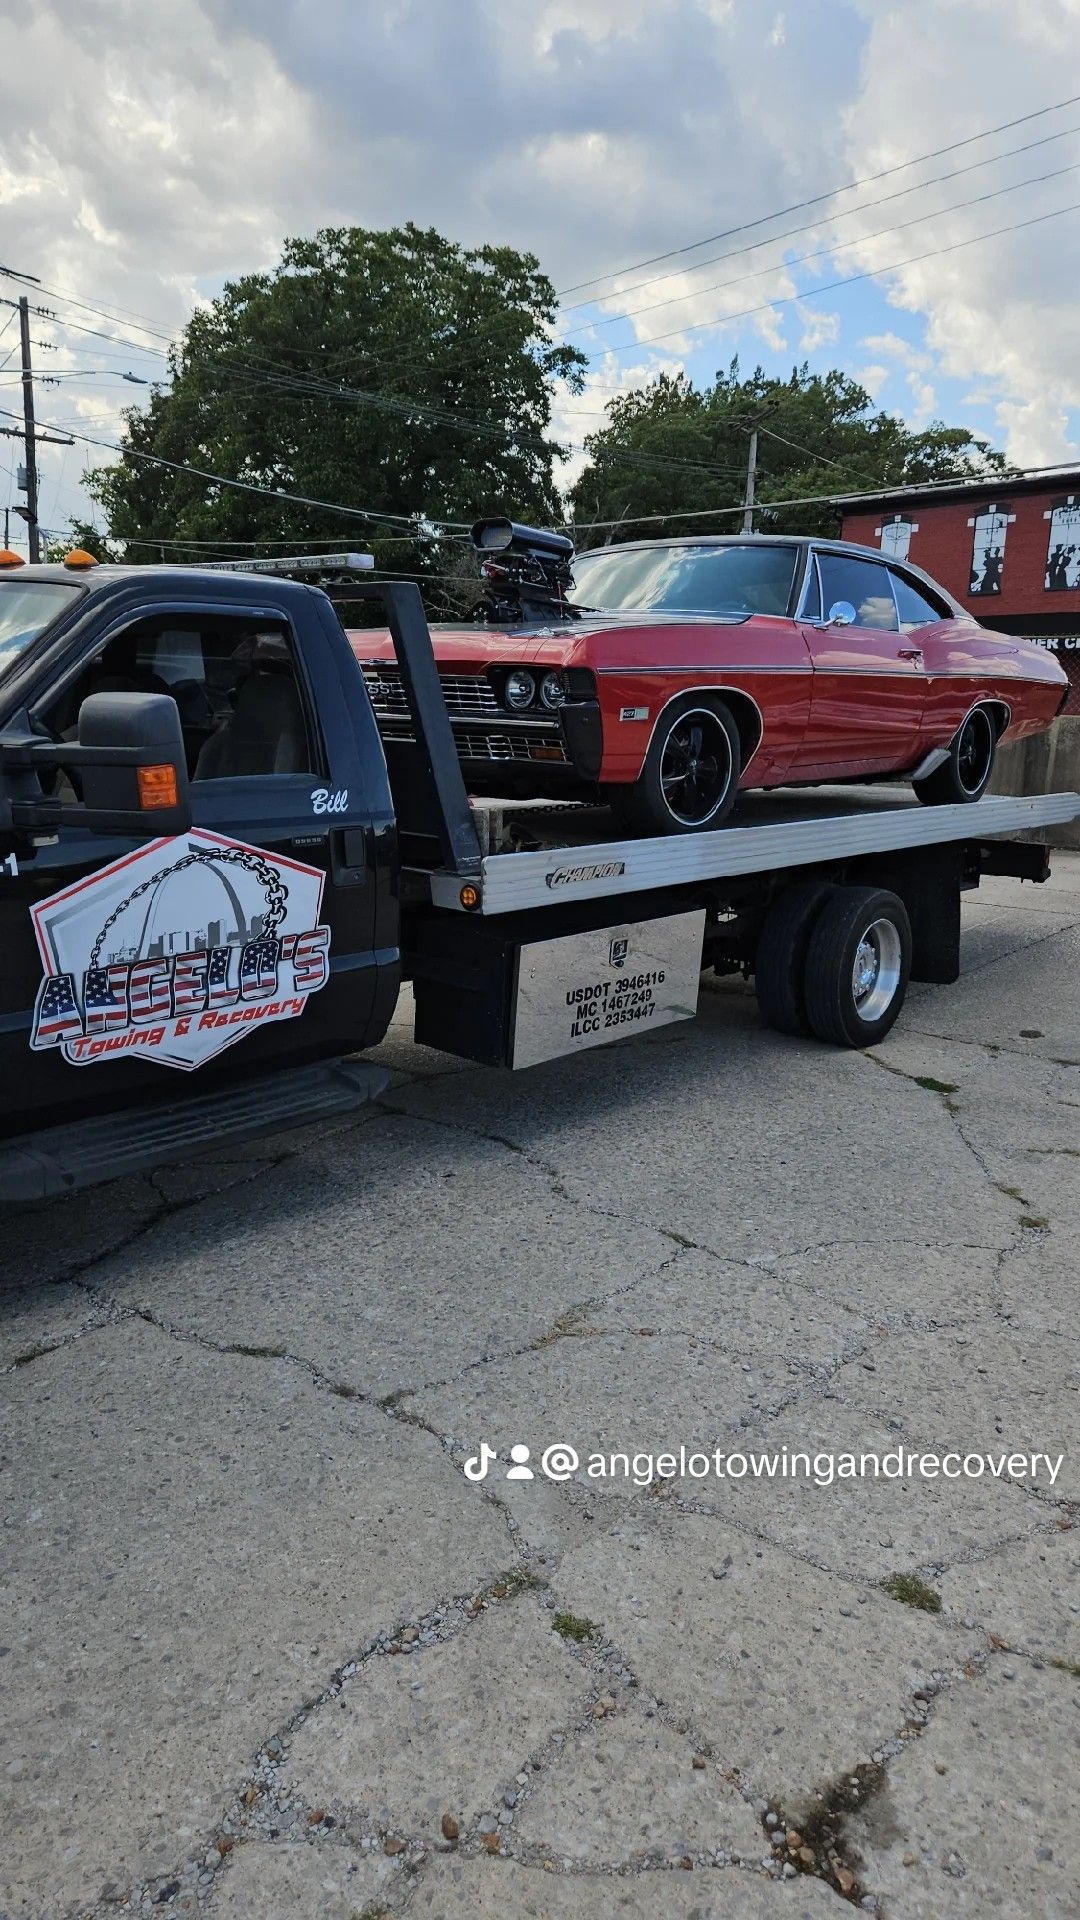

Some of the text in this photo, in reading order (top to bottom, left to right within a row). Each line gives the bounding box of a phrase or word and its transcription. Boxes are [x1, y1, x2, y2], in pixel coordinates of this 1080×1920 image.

[310, 788, 349, 815] Bill
[550, 862, 624, 889] CHAMPION
[33, 929, 330, 1047] ANGELO'S
[565, 970, 665, 1006] USDOT 3946416
[576, 988, 652, 1020] MC 1467249
[73, 996, 306, 1059] Towing & Recovery
[570, 1002, 656, 1038] ILCC 2353447
